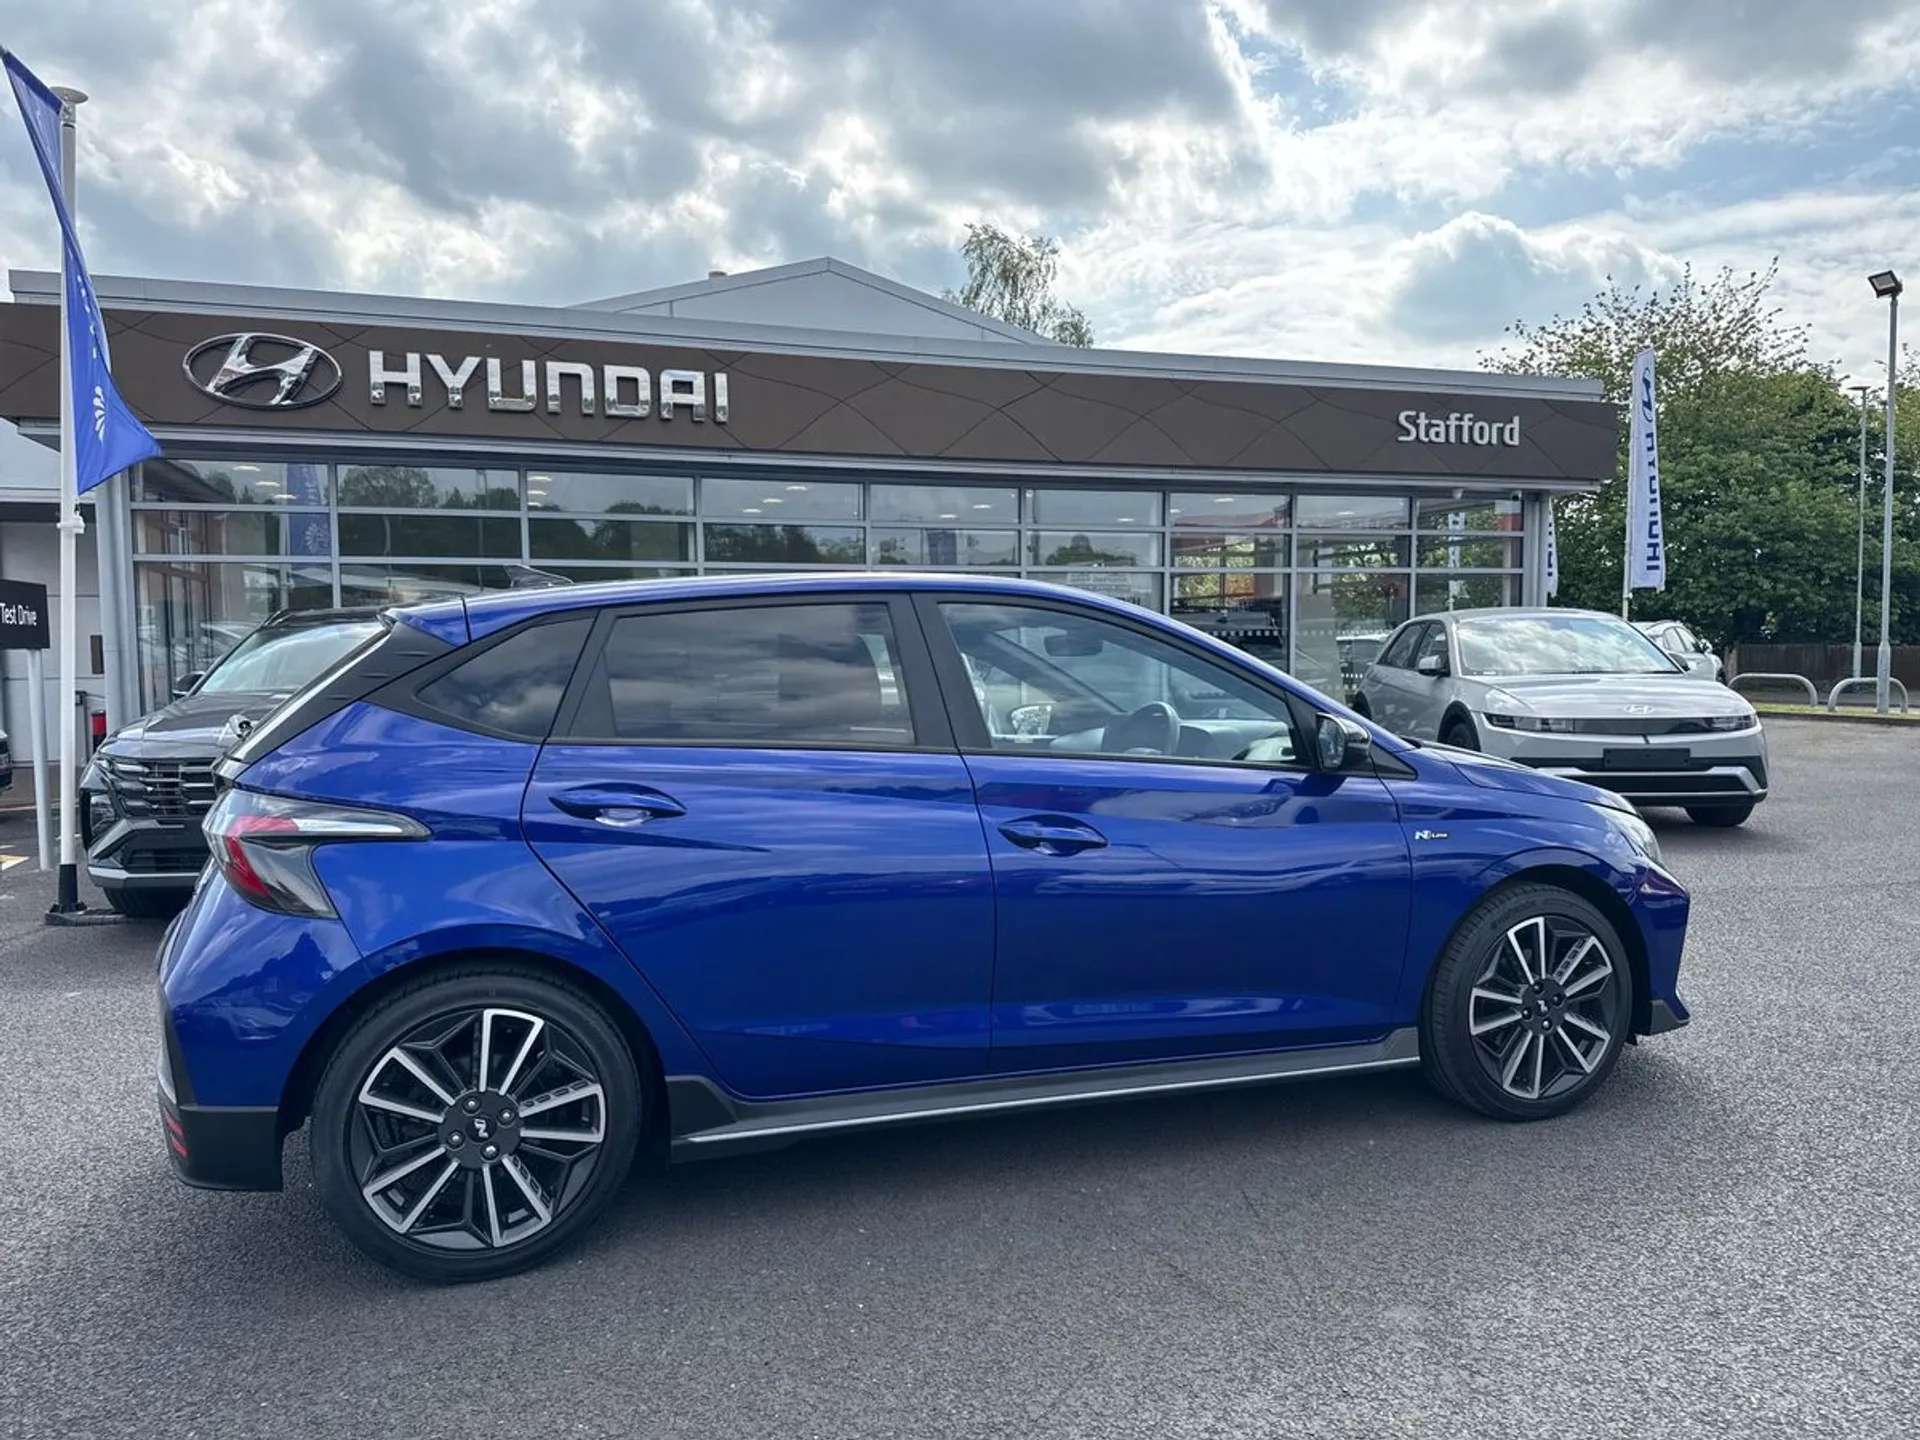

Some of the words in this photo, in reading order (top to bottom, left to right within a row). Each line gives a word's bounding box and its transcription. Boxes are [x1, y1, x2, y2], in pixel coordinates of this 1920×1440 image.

[368, 350, 729, 424] HYUNDAI
[1397, 410, 1520, 446] Stafford
[0, 602, 18, 625] Test
[18, 604, 38, 627] Drive
